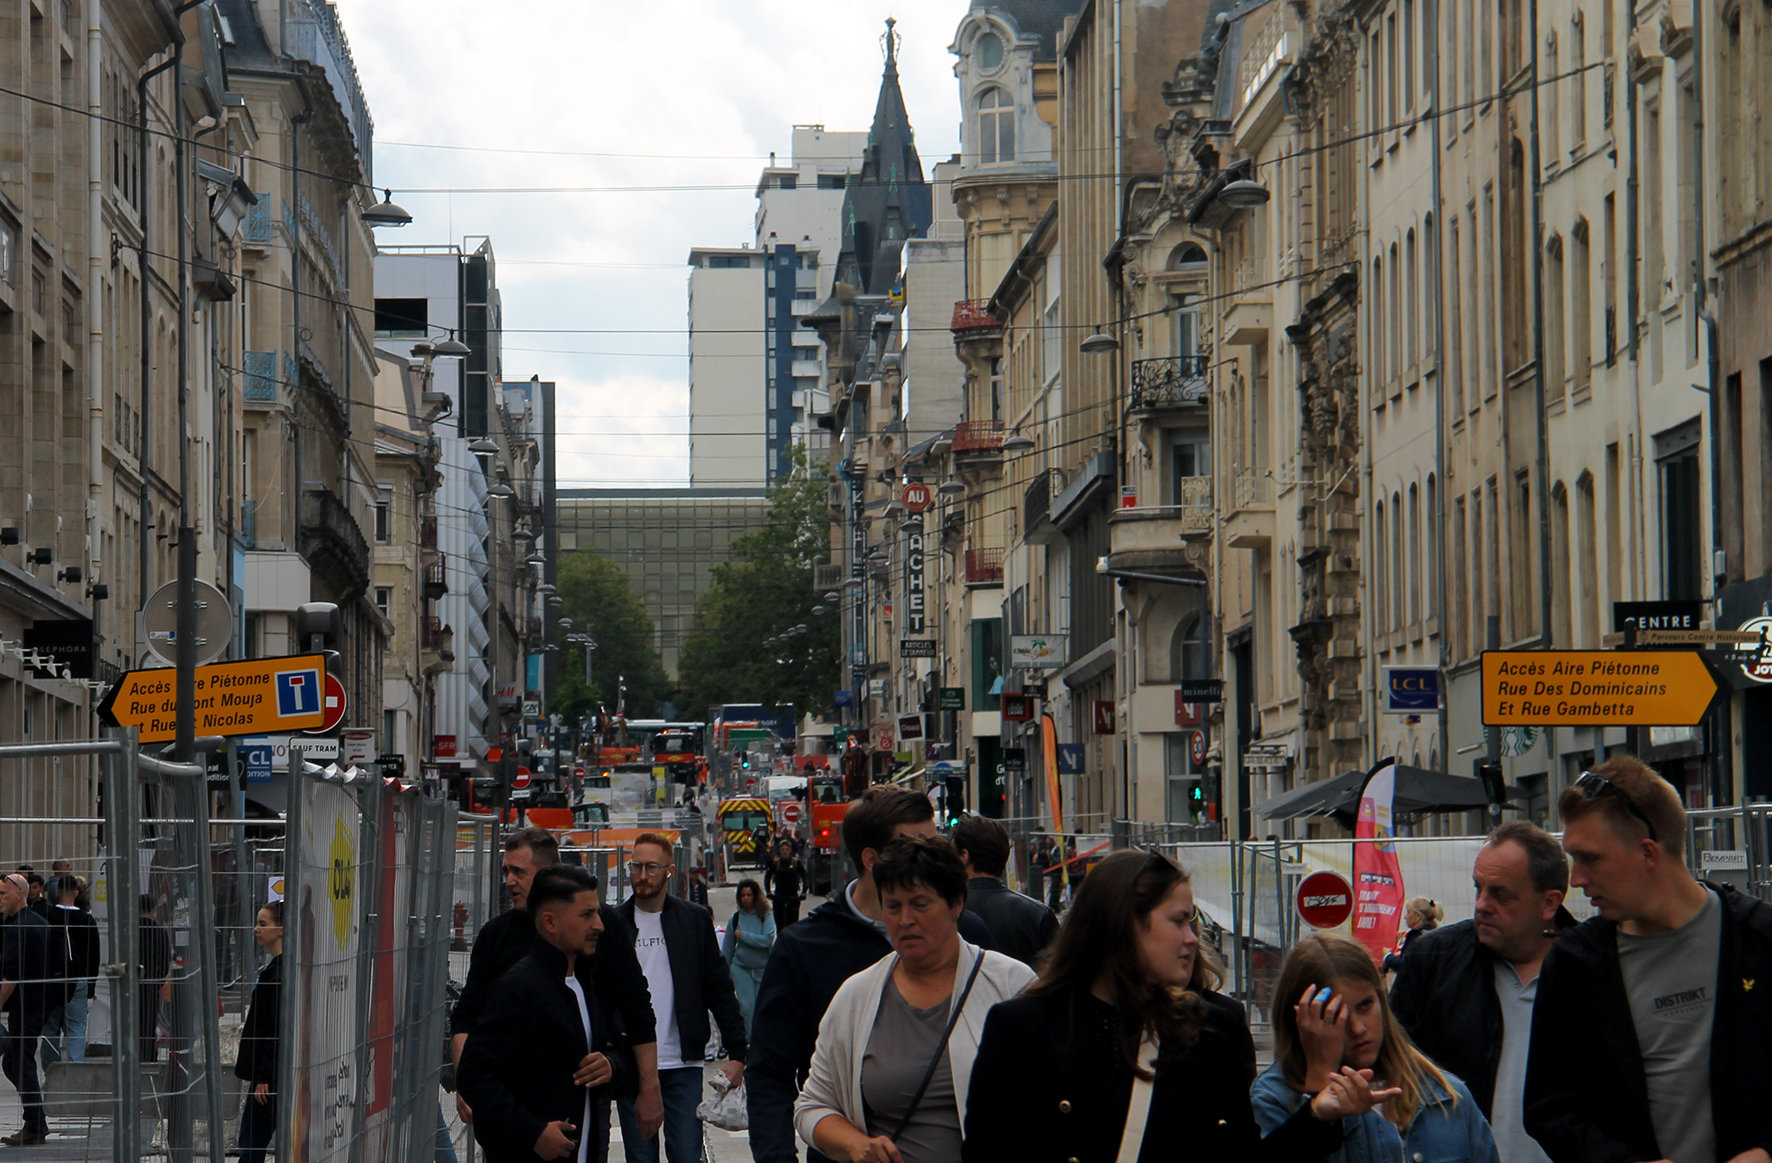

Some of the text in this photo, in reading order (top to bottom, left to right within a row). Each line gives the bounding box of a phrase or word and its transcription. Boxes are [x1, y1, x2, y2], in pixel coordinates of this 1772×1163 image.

[907, 490, 925, 503] AU
[1624, 615, 1692, 629] ENTRE
[1651, 632, 1758, 643] Parcours Centre Historique
[1498, 659, 1661, 676] Accès Aire Piétonne
[129, 680, 171, 697] Accès
[211, 672, 270, 690] Piétonne
[1183, 685, 1221, 696] minelli
[1391, 677, 1432, 691] LCL
[1498, 681, 1667, 696] Rue Des Dominicains
[130, 693, 263, 716] Rue du ont Mouja
[1498, 701, 1635, 716] Et Rue Gambetta
[150, 718, 176, 734] Rue
[202, 712, 254, 729] Nicolas
[292, 744, 313, 753] SAUF
[315, 744, 337, 753] TRAM
[438, 742, 455, 750] SFR
[246, 750, 270, 765] CL
[1703, 852, 1745, 863] REMPART
[1654, 987, 1707, 1010] DISTRIKT
